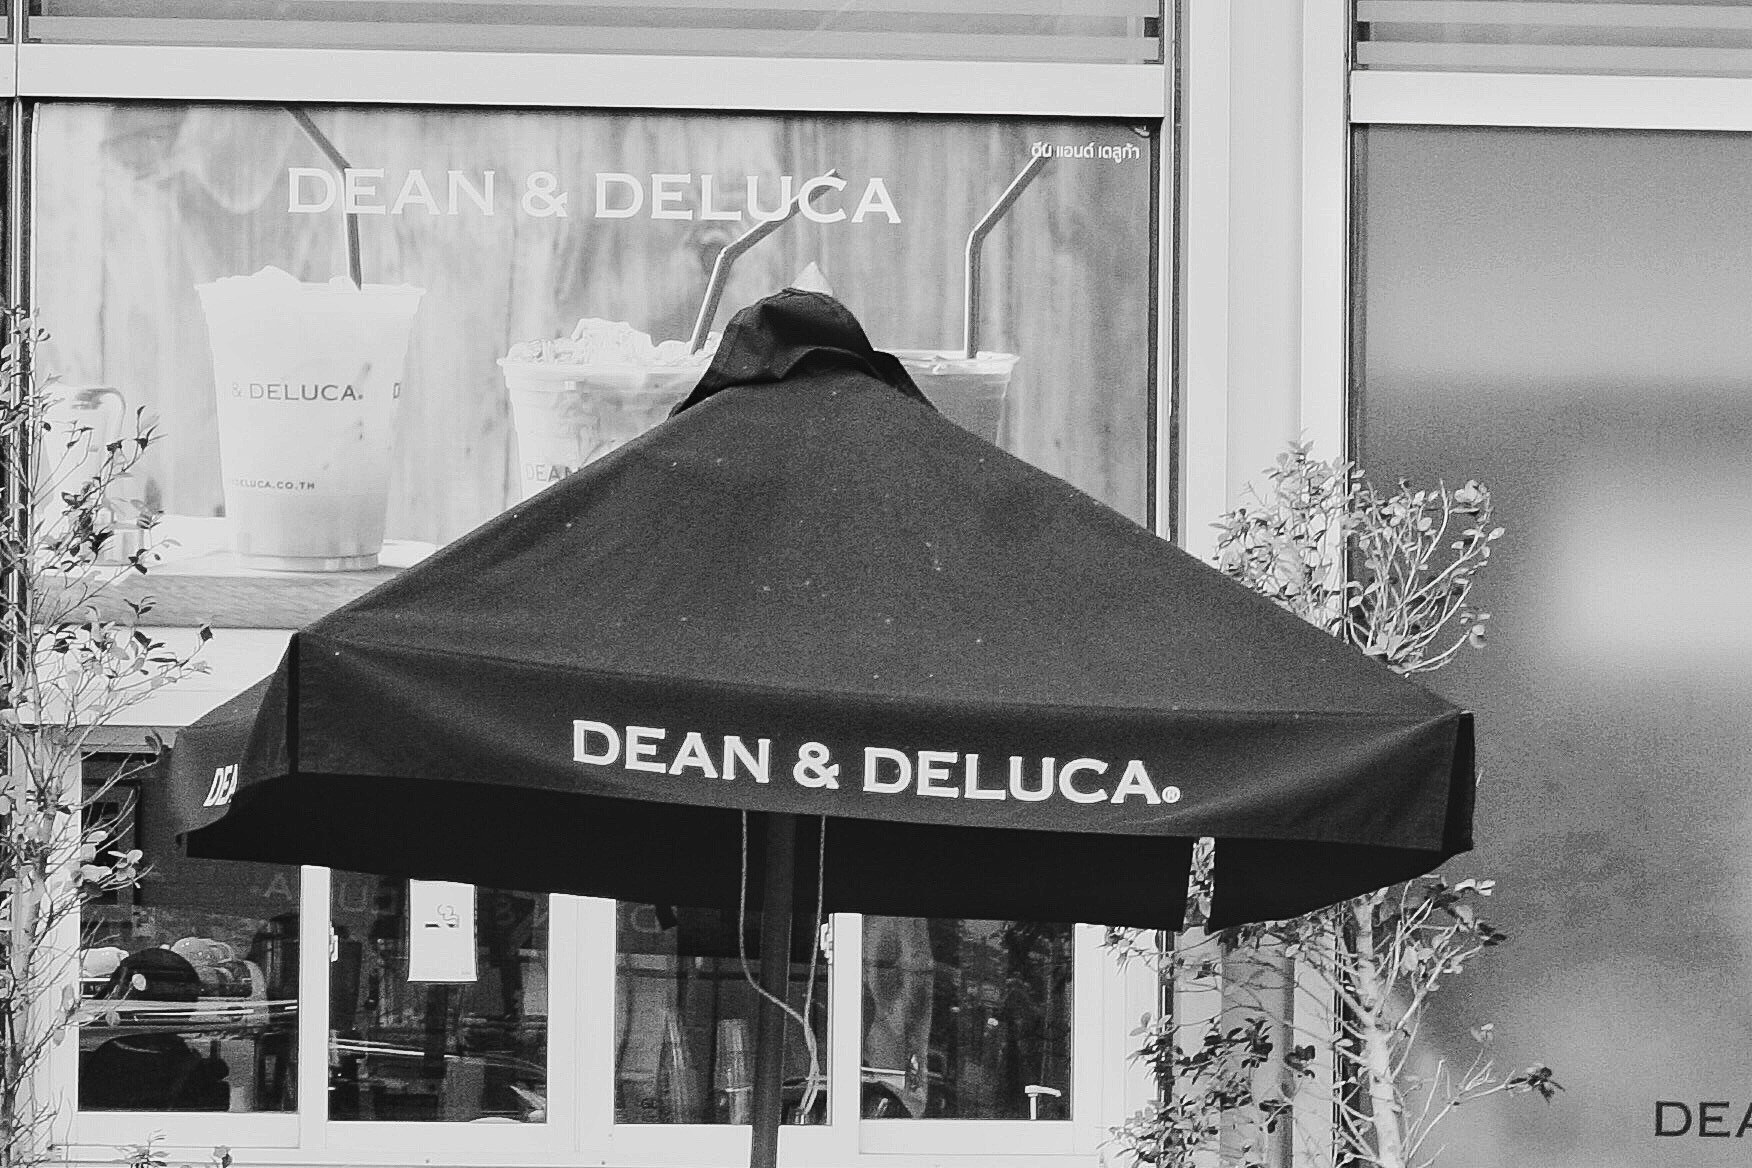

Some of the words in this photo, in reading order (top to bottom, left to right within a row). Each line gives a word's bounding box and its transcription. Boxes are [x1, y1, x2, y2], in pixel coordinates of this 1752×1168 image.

[1056, 141, 1095, 158] แอนด์
[1098, 142, 1140, 163] เดลูก้า
[288, 167, 496, 216] DEAN
[522, 171, 568, 217] &
[595, 172, 902, 224] DELUCA
[573, 719, 770, 783] DEAN
[792, 741, 840, 789] &
